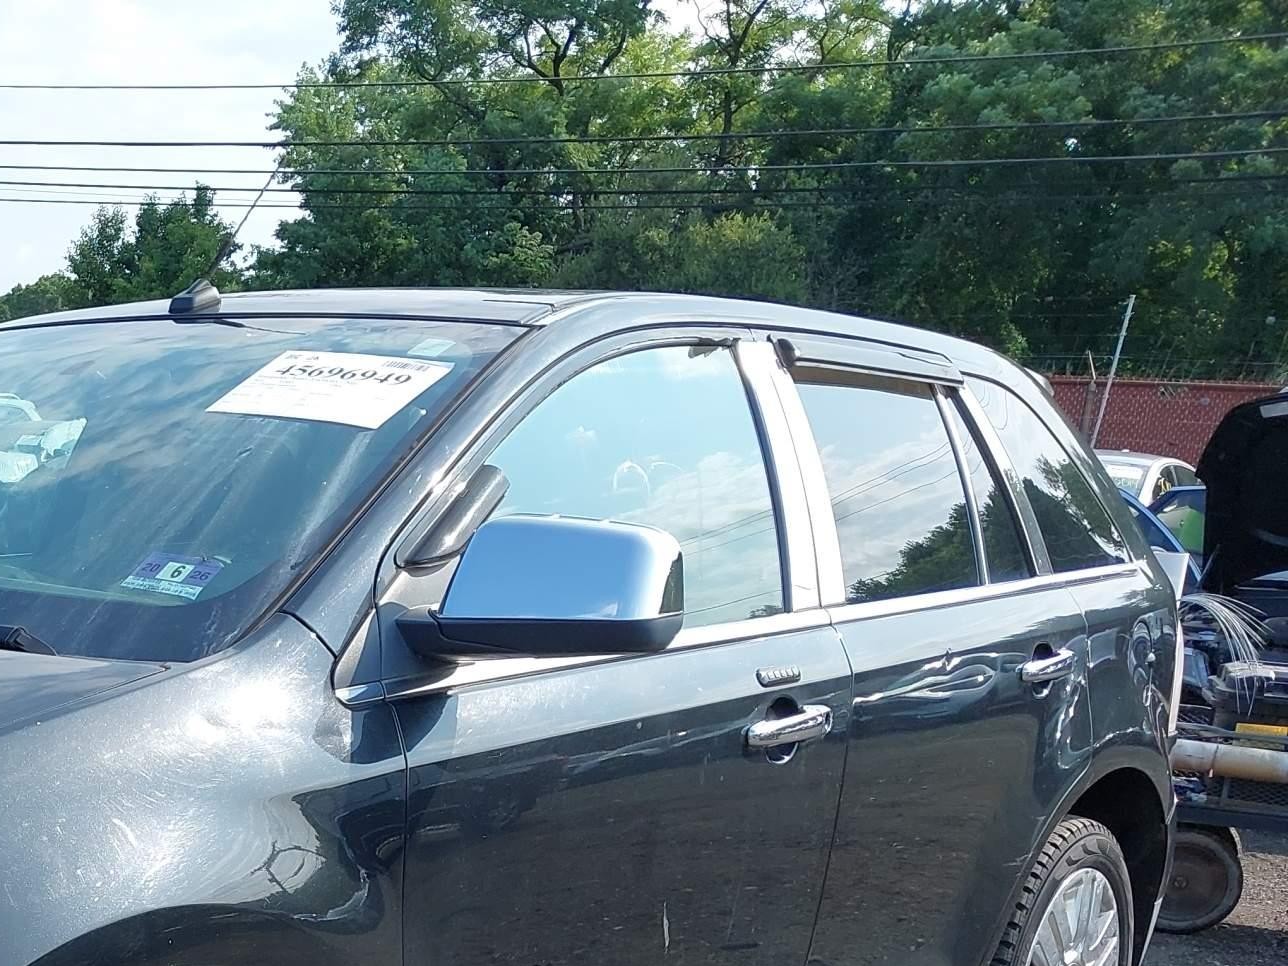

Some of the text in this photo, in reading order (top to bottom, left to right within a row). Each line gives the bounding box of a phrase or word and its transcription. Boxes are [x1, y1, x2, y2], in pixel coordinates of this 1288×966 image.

[276, 363, 412, 386] 45696949
[141, 562, 212, 581] 20 6 26
